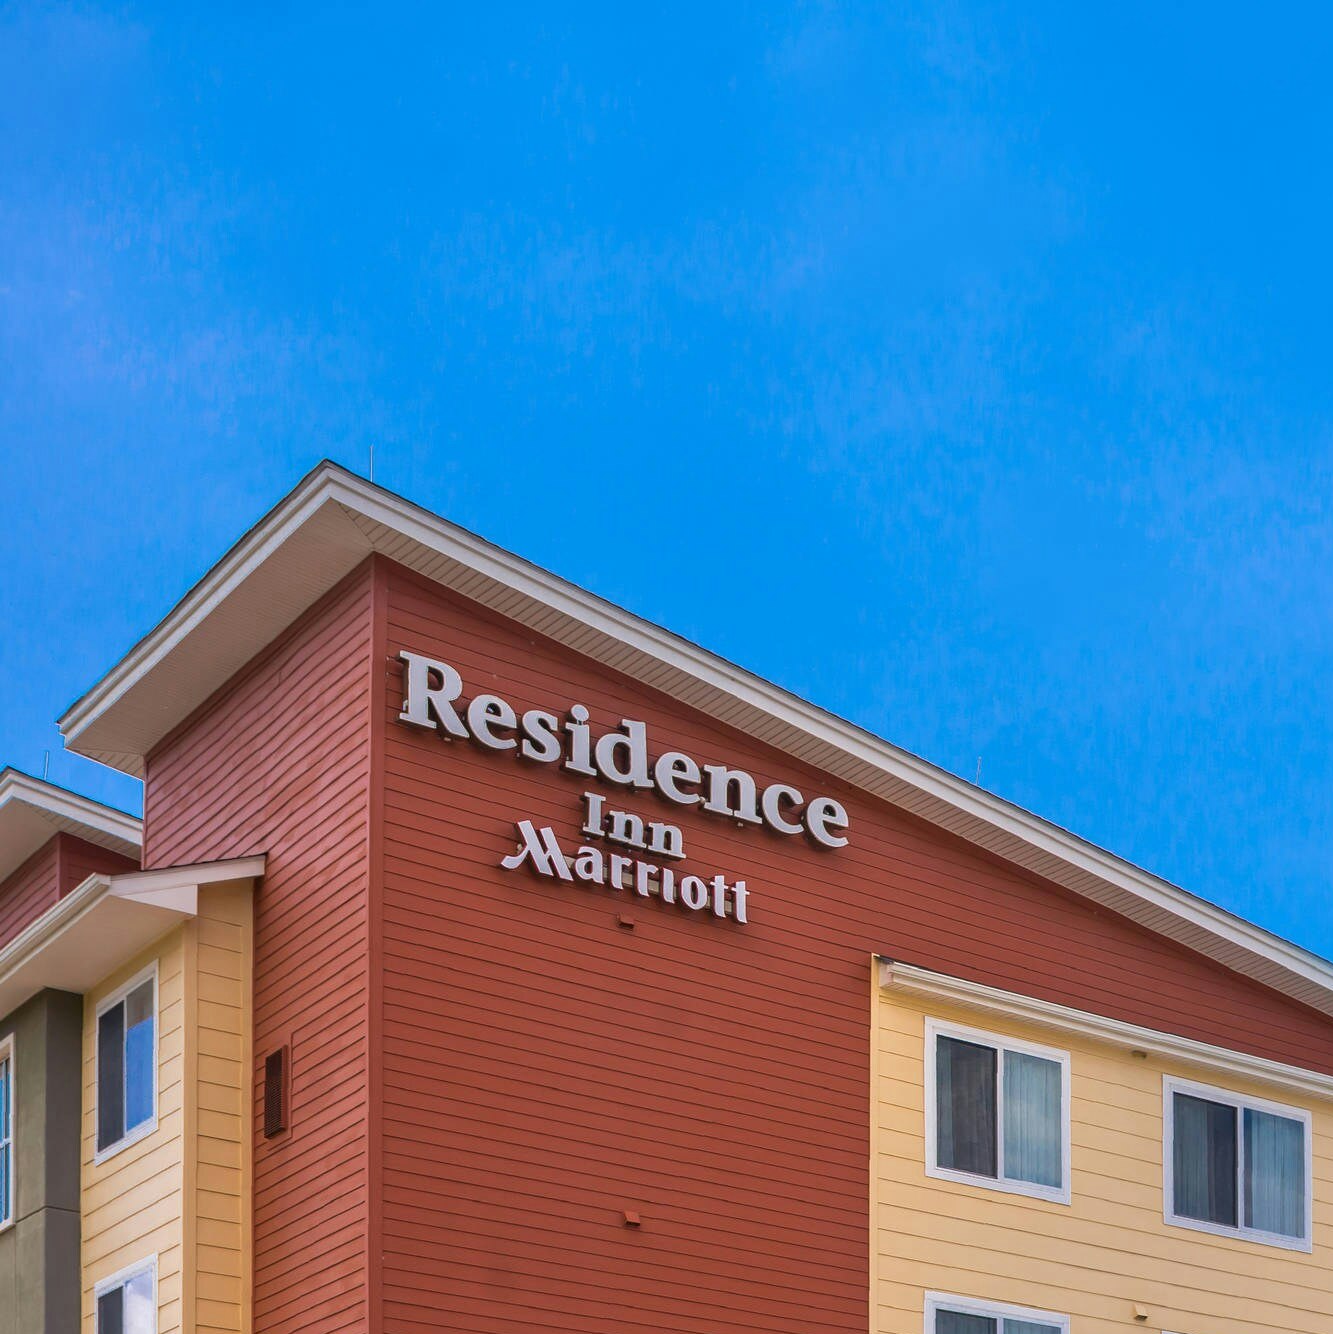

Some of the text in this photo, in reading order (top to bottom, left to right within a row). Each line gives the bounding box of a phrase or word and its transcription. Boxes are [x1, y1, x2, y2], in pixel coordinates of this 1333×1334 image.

[398, 650, 849, 848] Residence
[501, 820, 750, 924] Marriott
[582, 791, 686, 859] Inn
